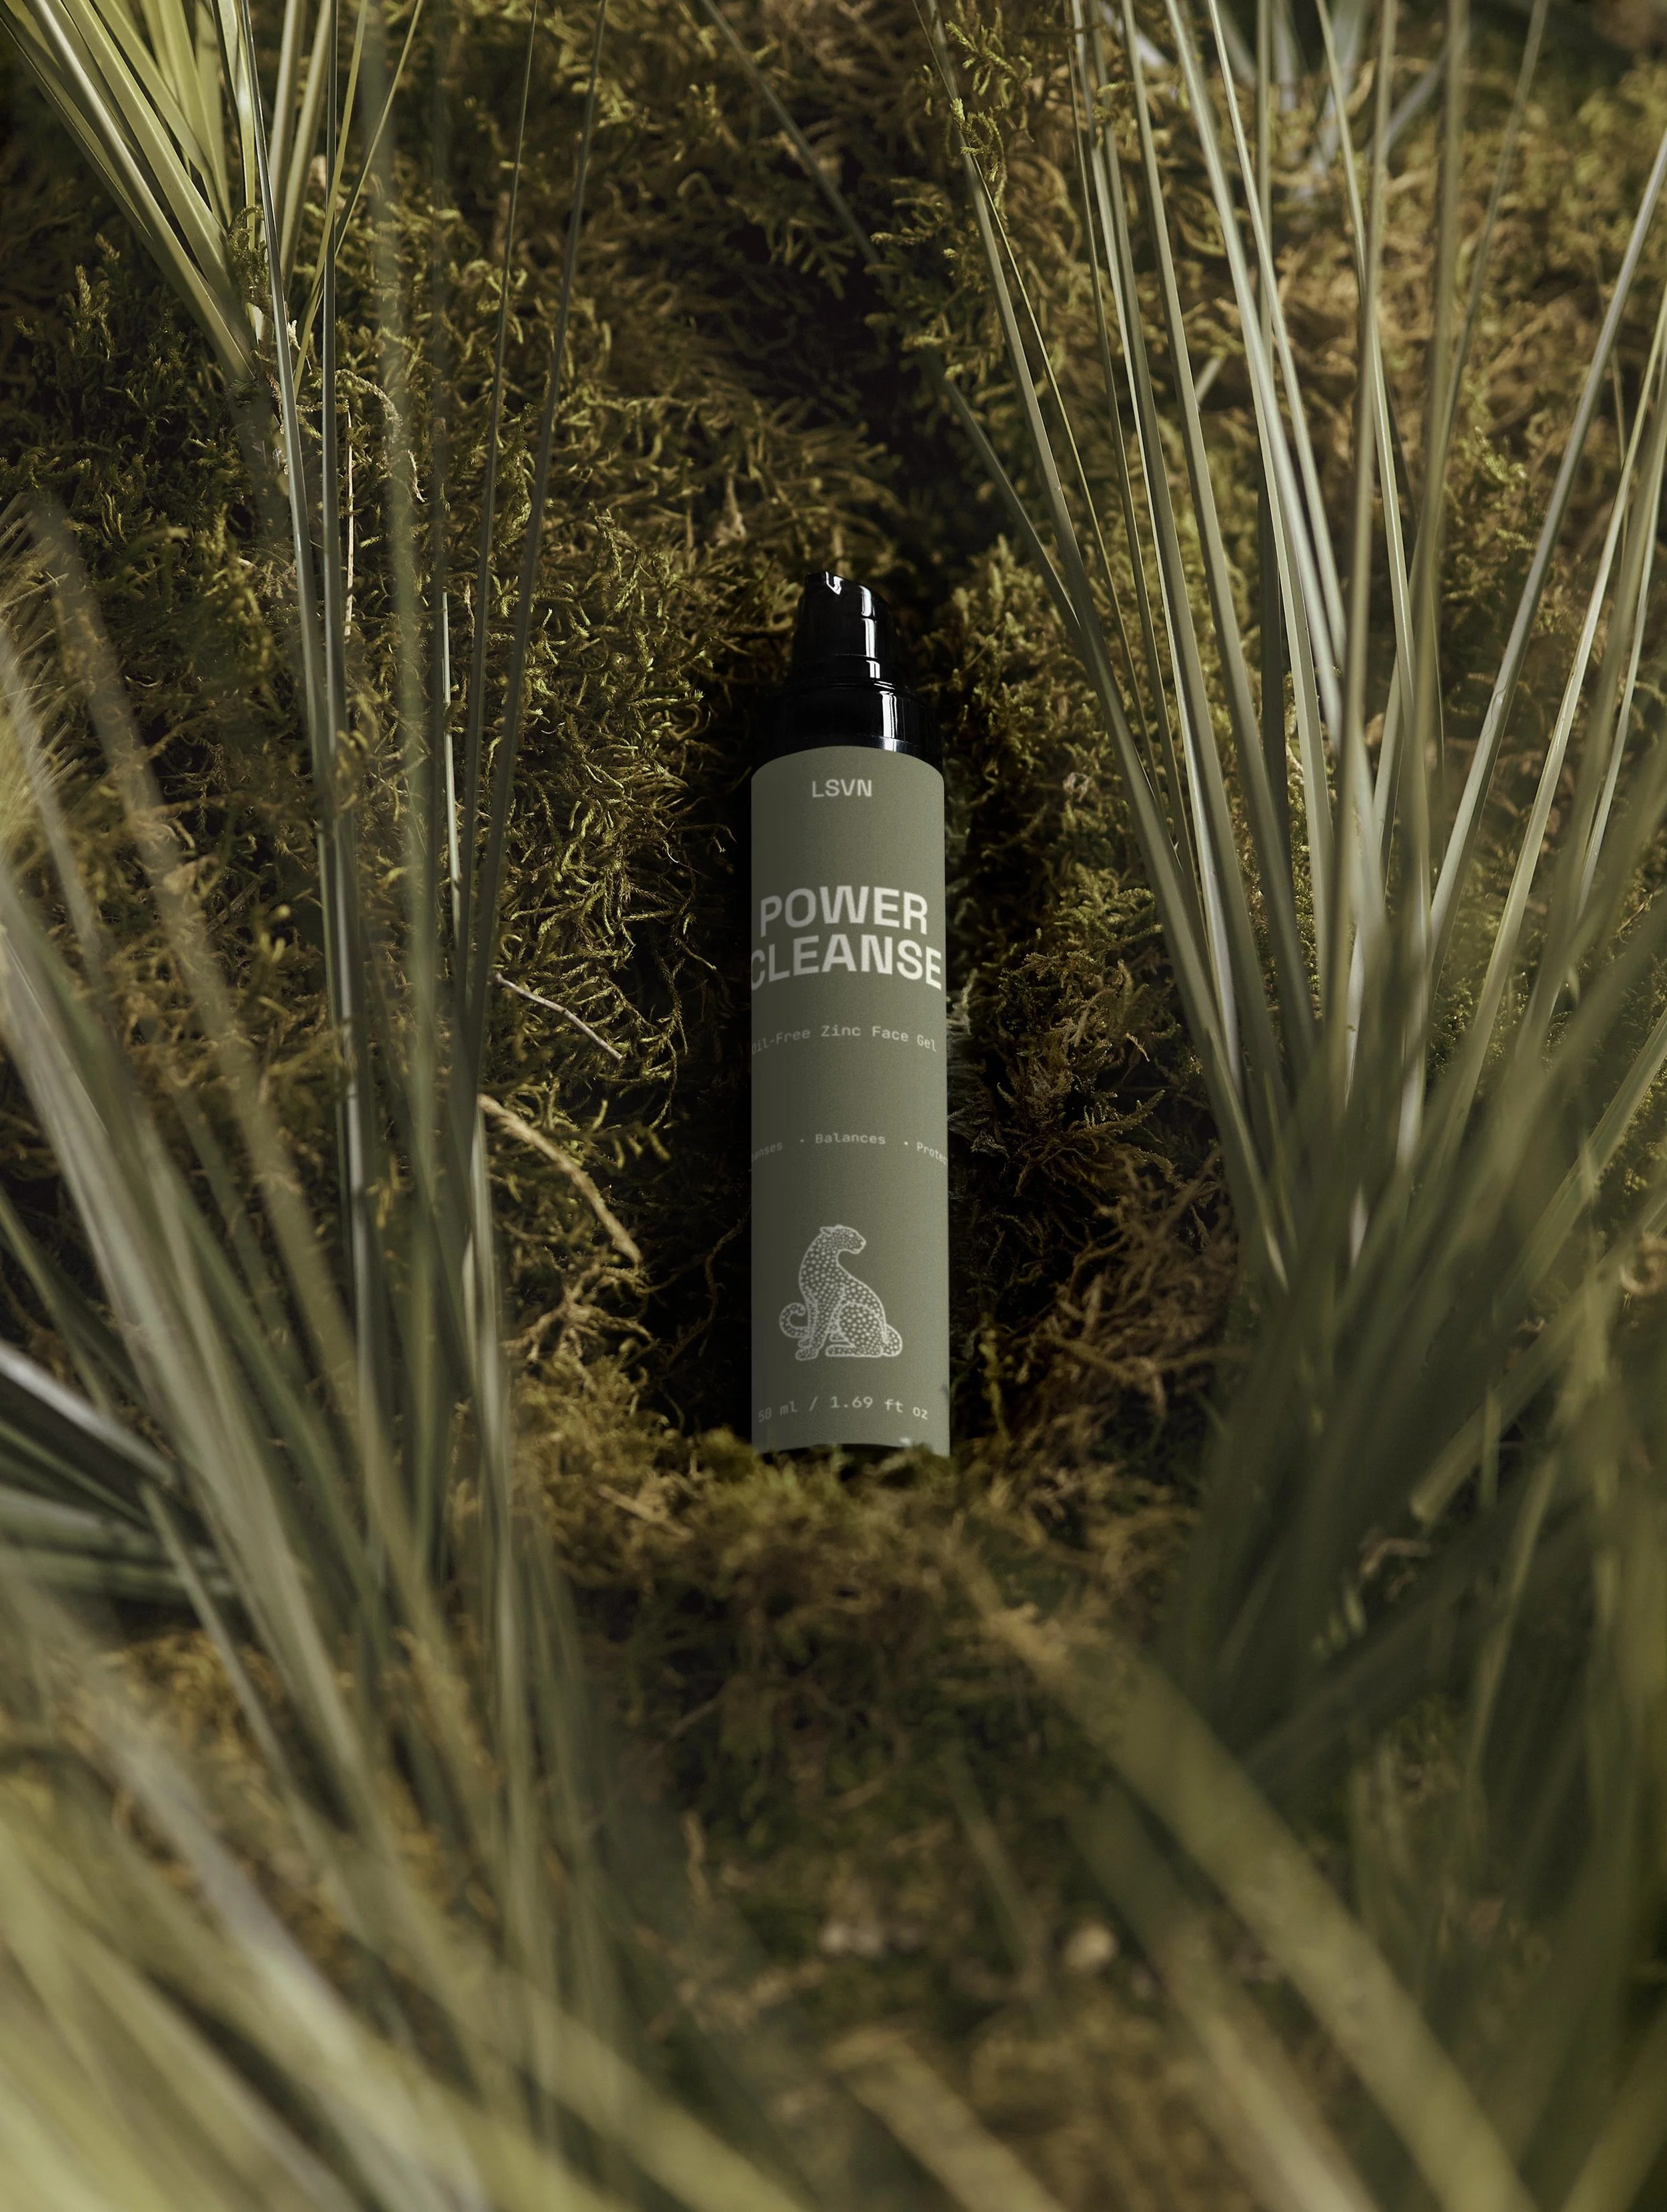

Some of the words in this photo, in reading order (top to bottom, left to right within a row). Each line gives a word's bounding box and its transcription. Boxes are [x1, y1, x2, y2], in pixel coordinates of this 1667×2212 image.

[812, 779, 872, 798] LSVN
[760, 885, 928, 938] POWER
[751, 934, 942, 990] CLEANSE
[751, 1028, 811, 1055] Oil-Free
[821, 1025, 862, 1038] Zinc
[872, 1026, 909, 1042] Face
[917, 1034, 936, 1052] Gel
[815, 1132, 886, 1145] Balances
[758, 1406, 772, 1423] 50
[779, 1400, 798, 1416] ml
[809, 1396, 819, 1412] /
[830, 1396, 874, 1408] 1.69
[884, 1398, 904, 1413] ft
[912, 1406, 928, 1420] oz
